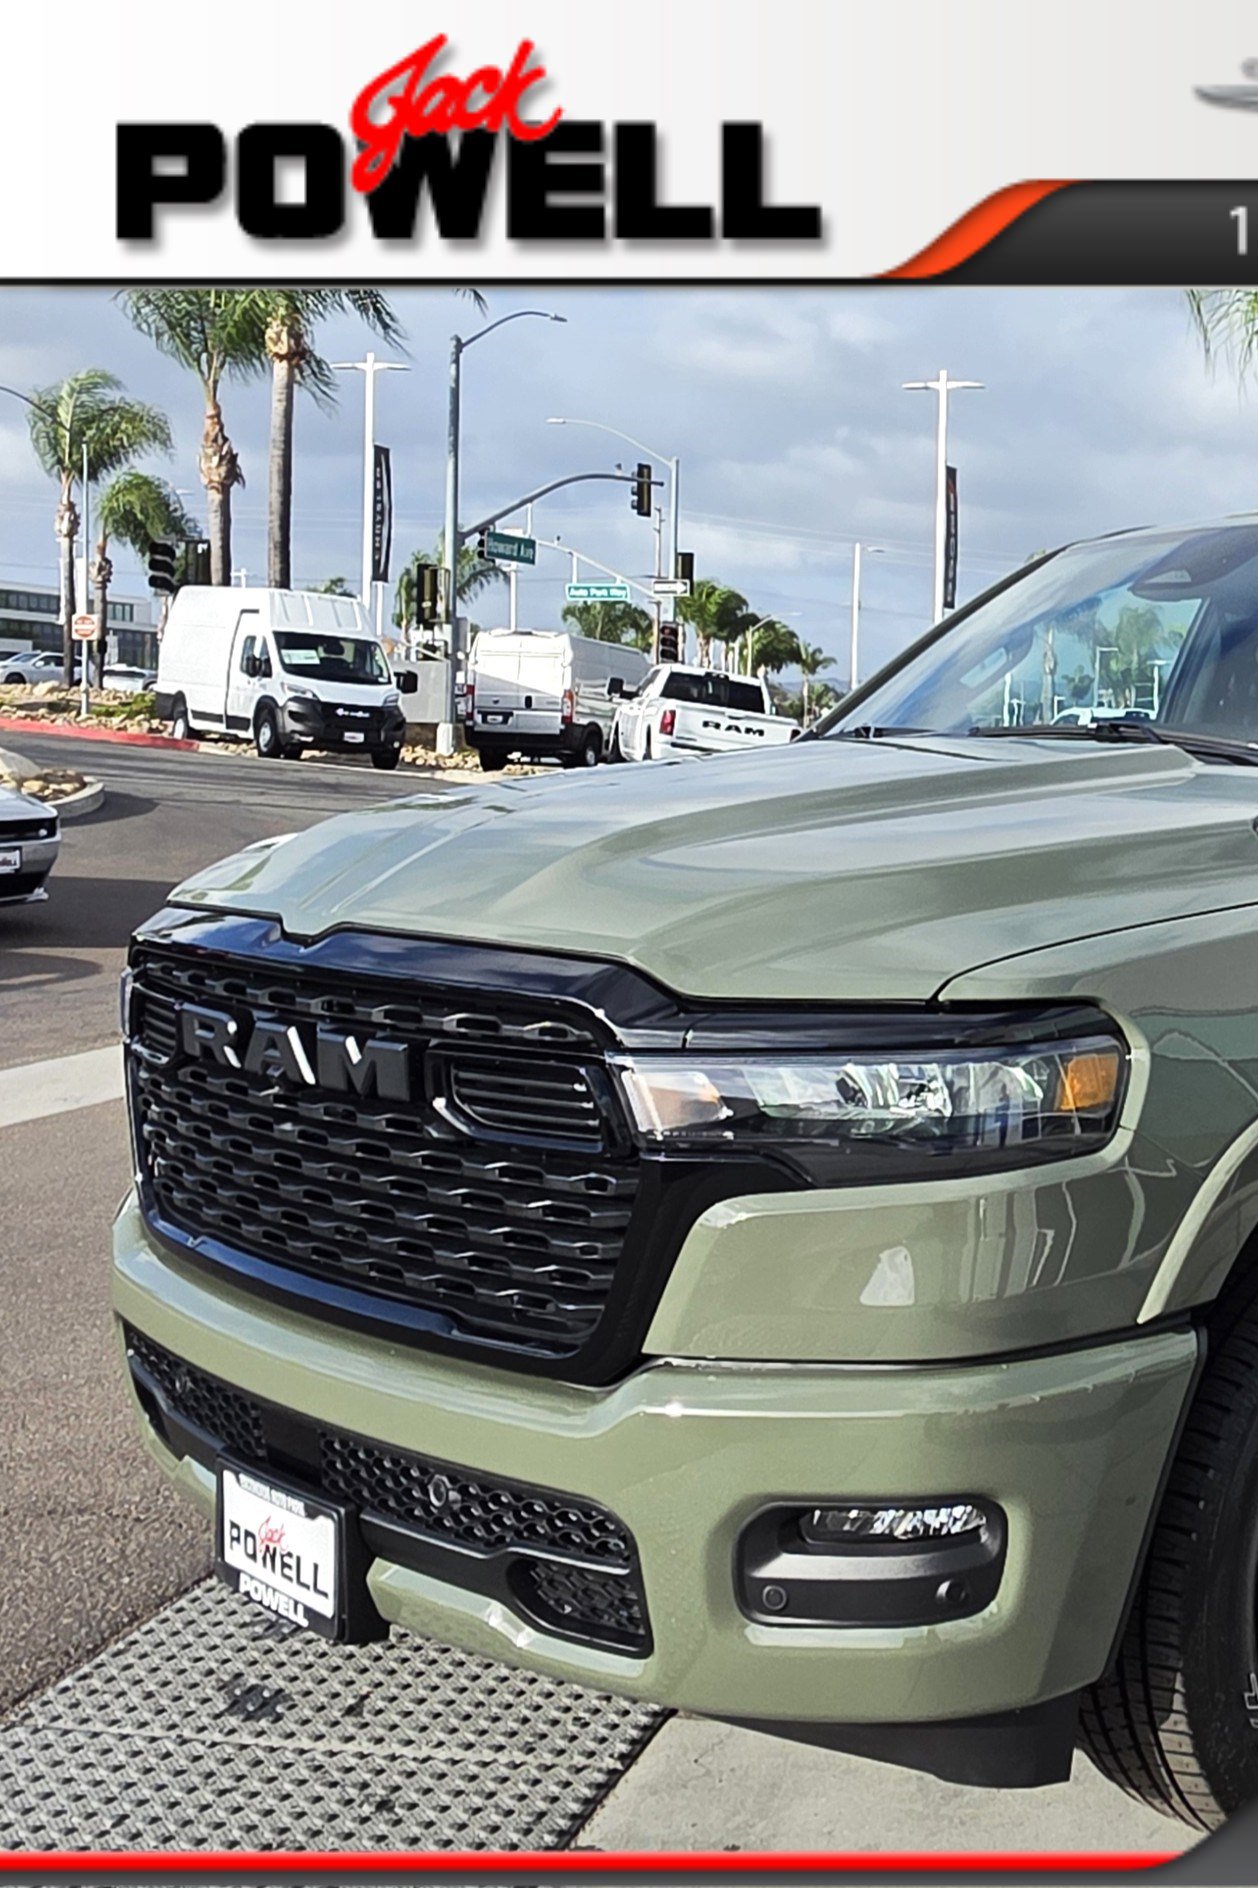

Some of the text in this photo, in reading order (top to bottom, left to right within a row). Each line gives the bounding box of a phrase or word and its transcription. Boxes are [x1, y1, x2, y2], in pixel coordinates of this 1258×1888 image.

[702, 720, 765, 737] RAM
[180, 1002, 411, 1101] RAM
[229, 1519, 330, 1600] POWELL
[258, 1515, 288, 1554] Jack
[238, 1571, 310, 1628] POWELL
